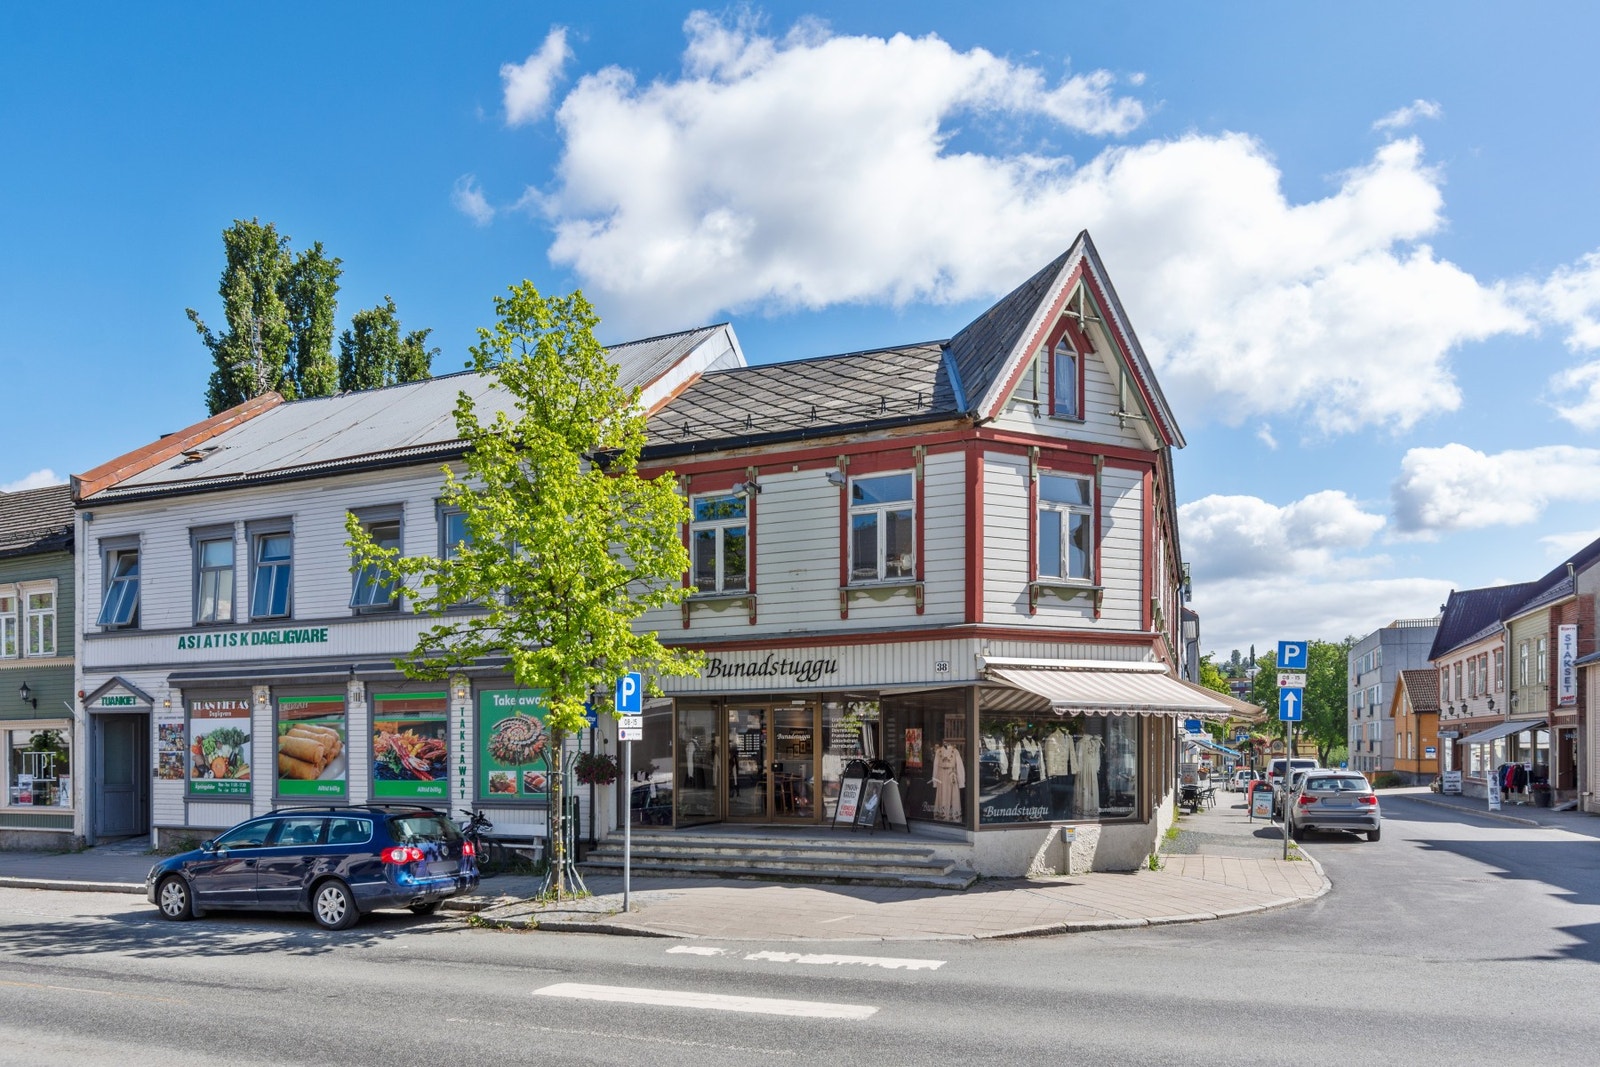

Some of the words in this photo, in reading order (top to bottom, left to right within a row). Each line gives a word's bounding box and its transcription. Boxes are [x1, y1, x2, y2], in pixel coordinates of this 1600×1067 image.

[178, 632, 249, 650] ASIATISK
[251, 628, 329, 646] DAGLIGVARE
[1284, 644, 1300, 665] P
[1563, 634, 1572, 693] STAKSET
[707, 653, 838, 682] Bunadstuggu
[936, 662, 948, 672] 38
[493, 694, 516, 706] Take
[622, 677, 636, 707] P
[237, 700, 249, 710] AS
[984, 803, 1049, 820] Bunadstuggu
